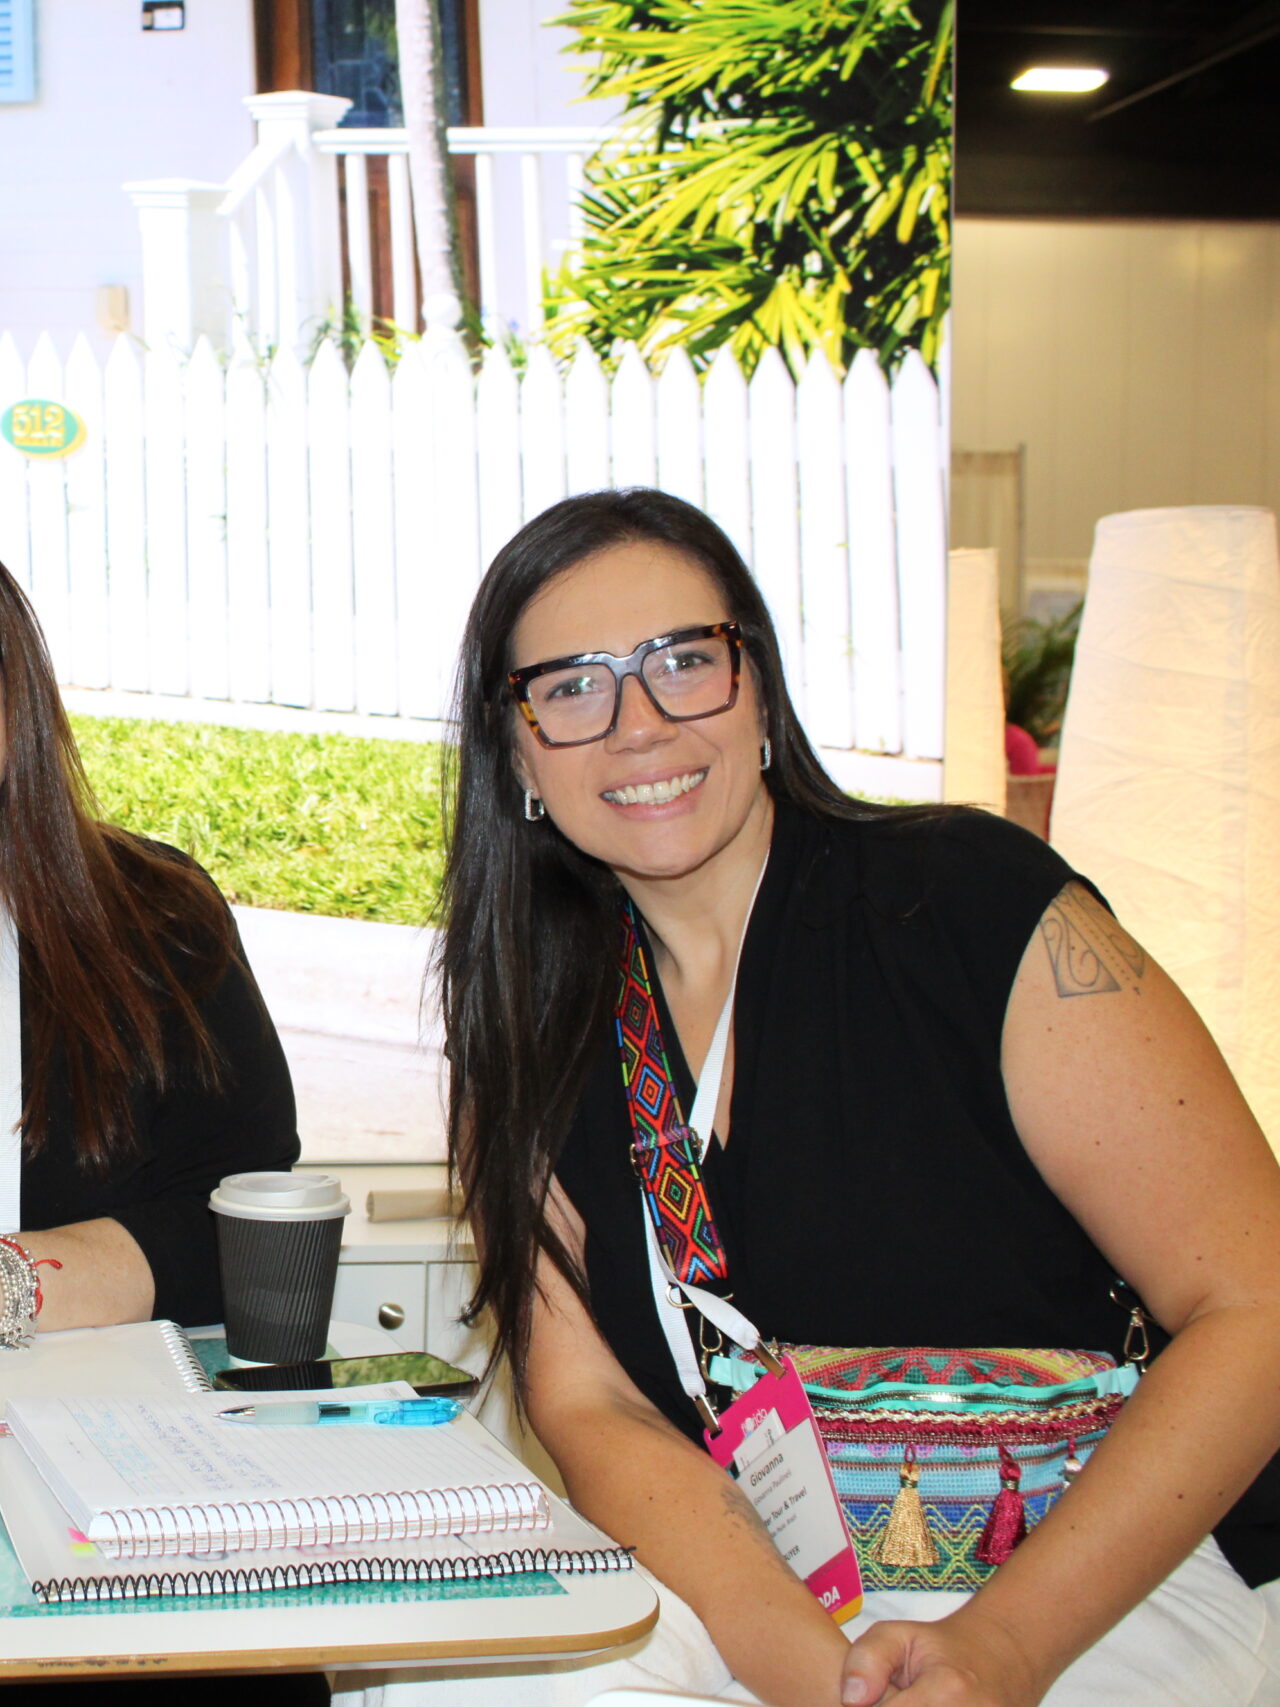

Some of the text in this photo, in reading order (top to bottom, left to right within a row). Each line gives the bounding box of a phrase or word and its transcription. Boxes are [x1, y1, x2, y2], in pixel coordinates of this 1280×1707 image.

[12, 404, 64, 438] 512
[750, 1453, 783, 1487] Giovanna
[789, 1486, 807, 1505] Travel
